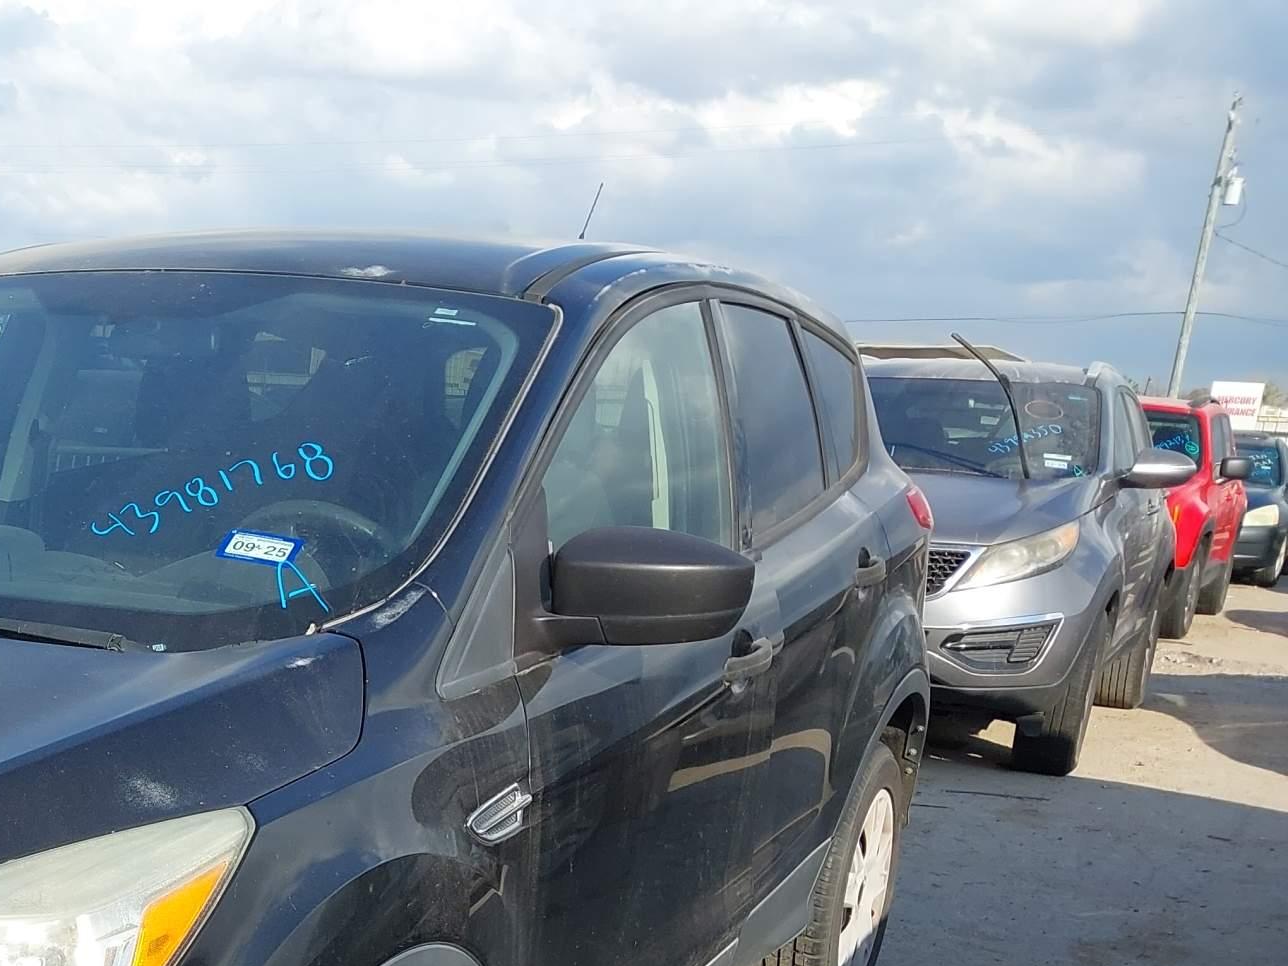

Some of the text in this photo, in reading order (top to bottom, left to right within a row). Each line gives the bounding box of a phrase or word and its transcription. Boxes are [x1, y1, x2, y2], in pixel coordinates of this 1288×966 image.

[91, 442, 334, 536] 43981768
[232, 540, 257, 553] 09
[263, 545, 289, 558] 25
[276, 560, 330, 613] A
